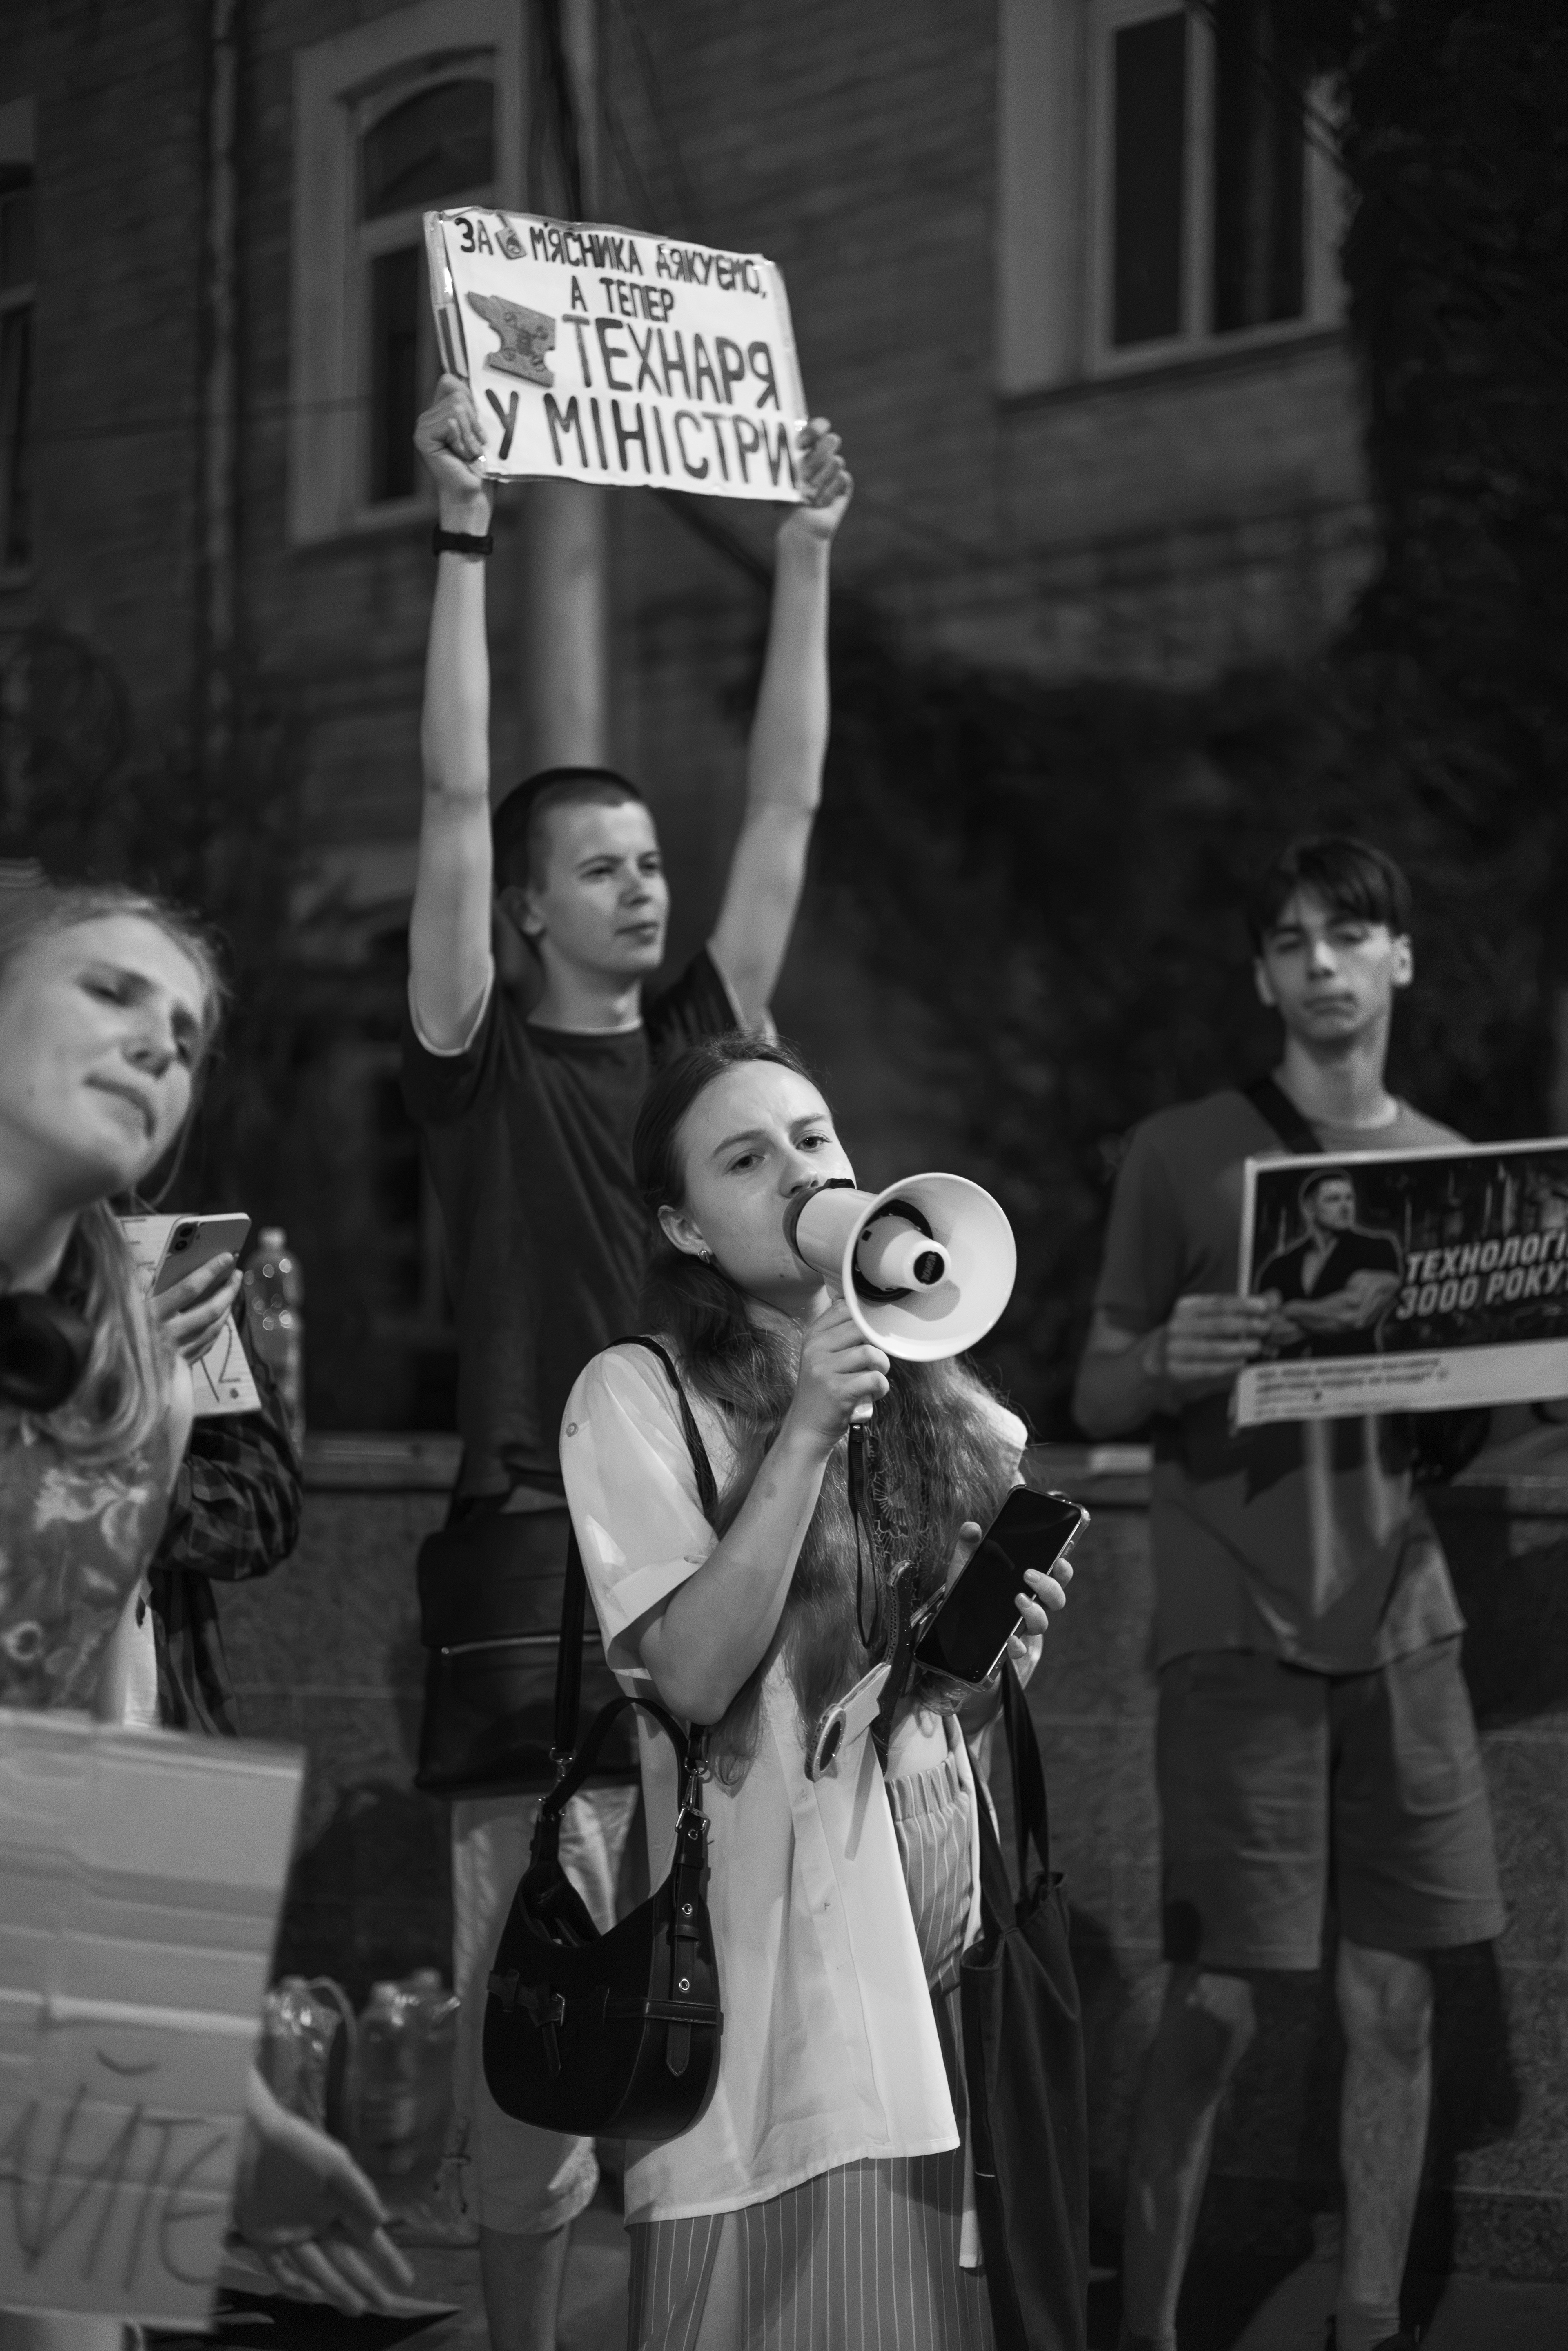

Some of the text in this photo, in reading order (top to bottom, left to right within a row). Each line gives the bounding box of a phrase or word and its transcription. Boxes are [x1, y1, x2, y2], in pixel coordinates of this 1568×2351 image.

[454, 217, 494, 256] ЗА
[571, 275, 675, 323] А ТЕПЕР
[562, 314, 781, 411] ТЕХНАРЯ
[485, 388, 796, 490] У МІНІСТРИ
[1405, 1229, 1568, 1286] ТЕХНОЛОГІ
[1395, 1260, 1568, 1321] 3000 РОКУ
